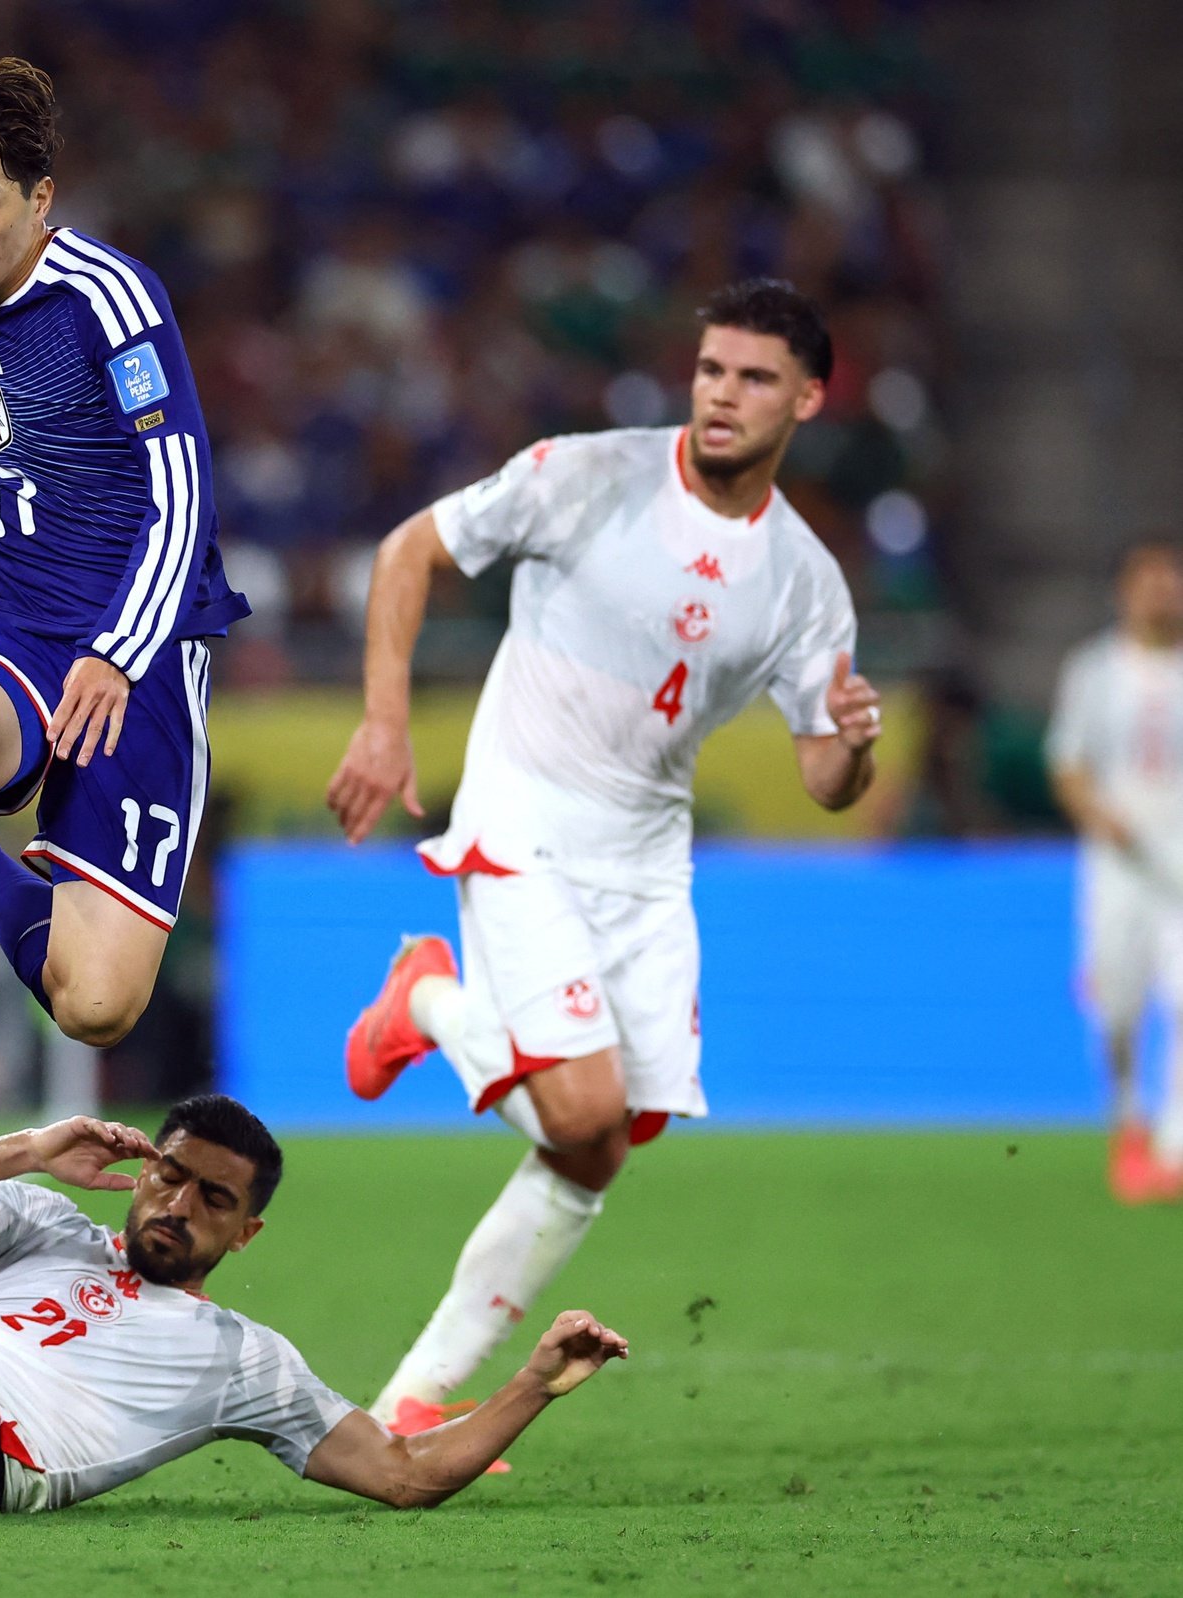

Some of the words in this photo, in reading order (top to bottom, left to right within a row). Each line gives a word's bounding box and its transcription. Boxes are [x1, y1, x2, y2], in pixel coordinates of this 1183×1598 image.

[130, 380, 154, 398] PEACE
[652, 659, 690, 726] 4
[121, 798, 180, 887] 17
[0, 1298, 87, 1348] 21
